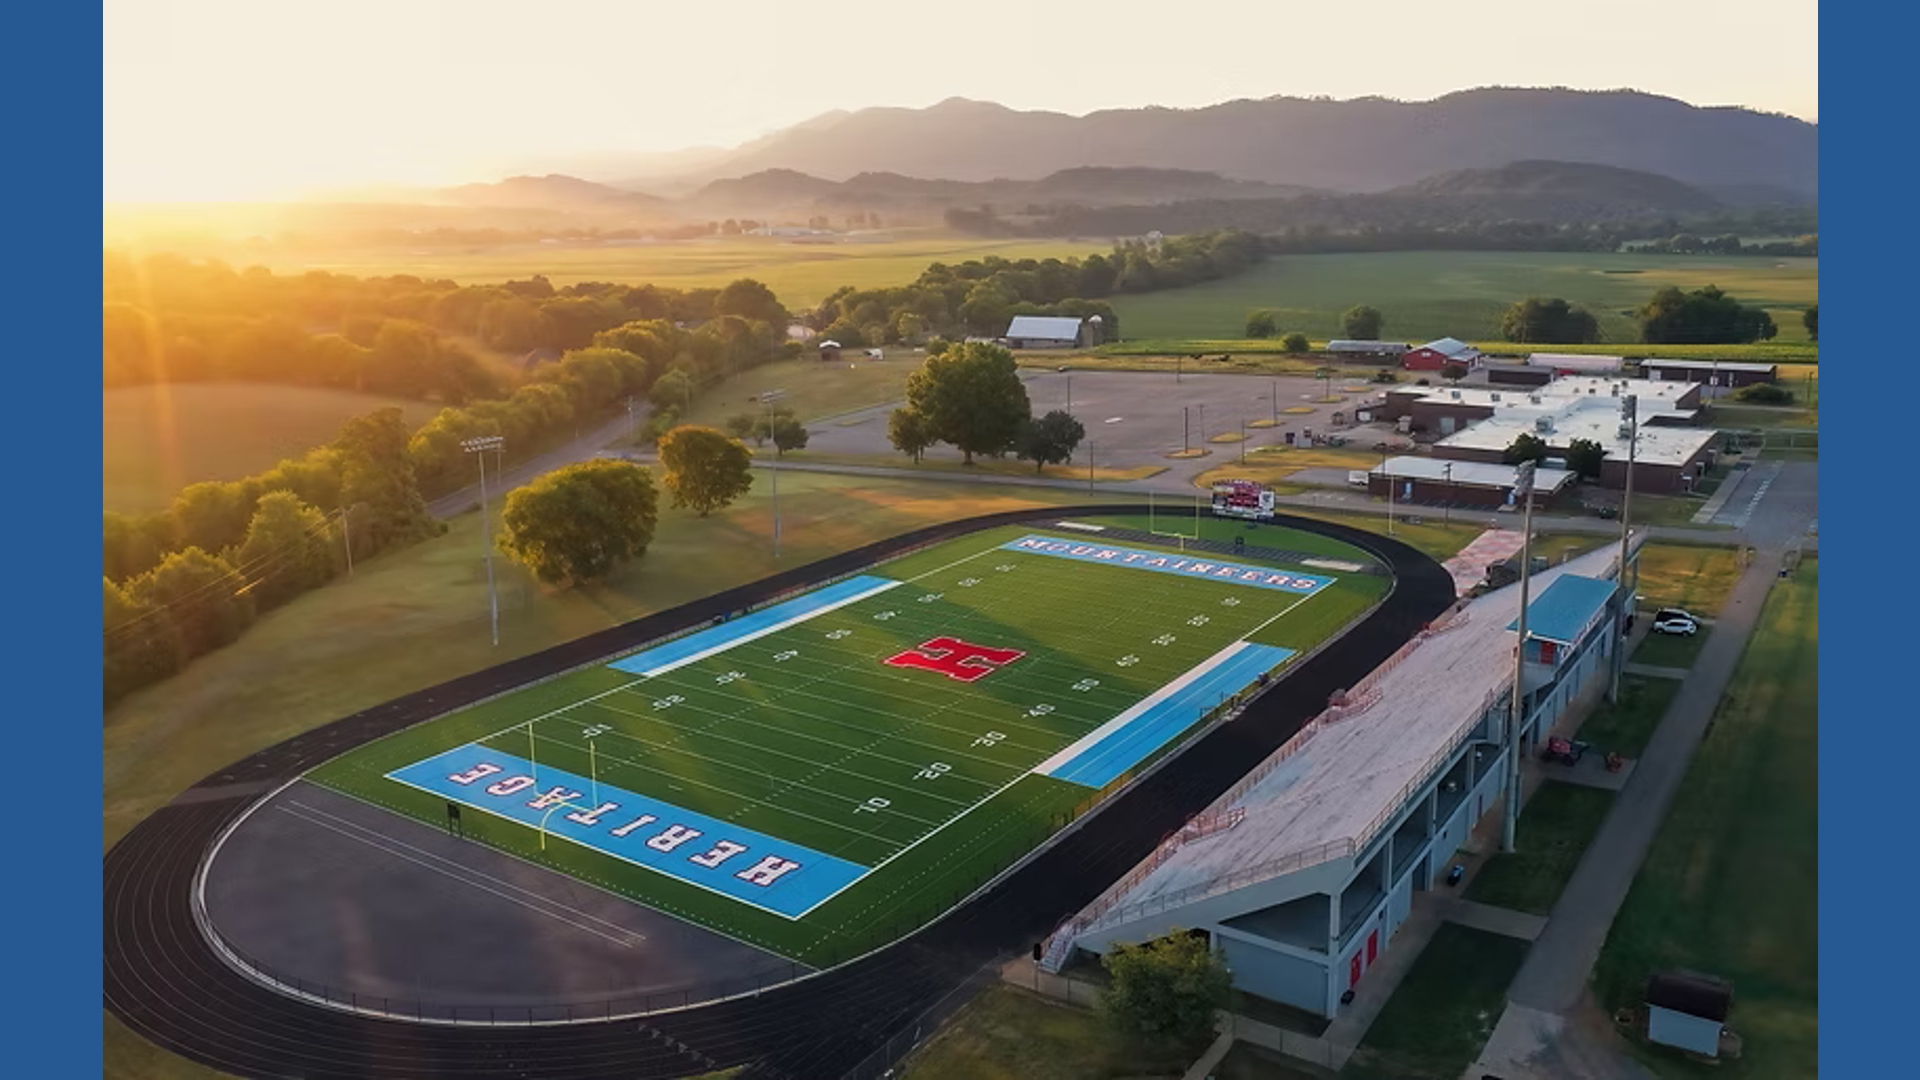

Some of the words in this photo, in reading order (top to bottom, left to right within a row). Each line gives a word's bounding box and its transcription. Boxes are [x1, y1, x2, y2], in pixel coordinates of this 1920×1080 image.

[1017, 536, 1318, 590] MOUNTAINEERS
[883, 636, 1027, 682] H
[1071, 678, 1100, 692] 50
[1029, 703, 1056, 717] 40
[977, 731, 1007, 747] 30
[919, 762, 952, 780] 20
[859, 797, 891, 813] 10
[448, 762, 801, 887] HERITAGE
